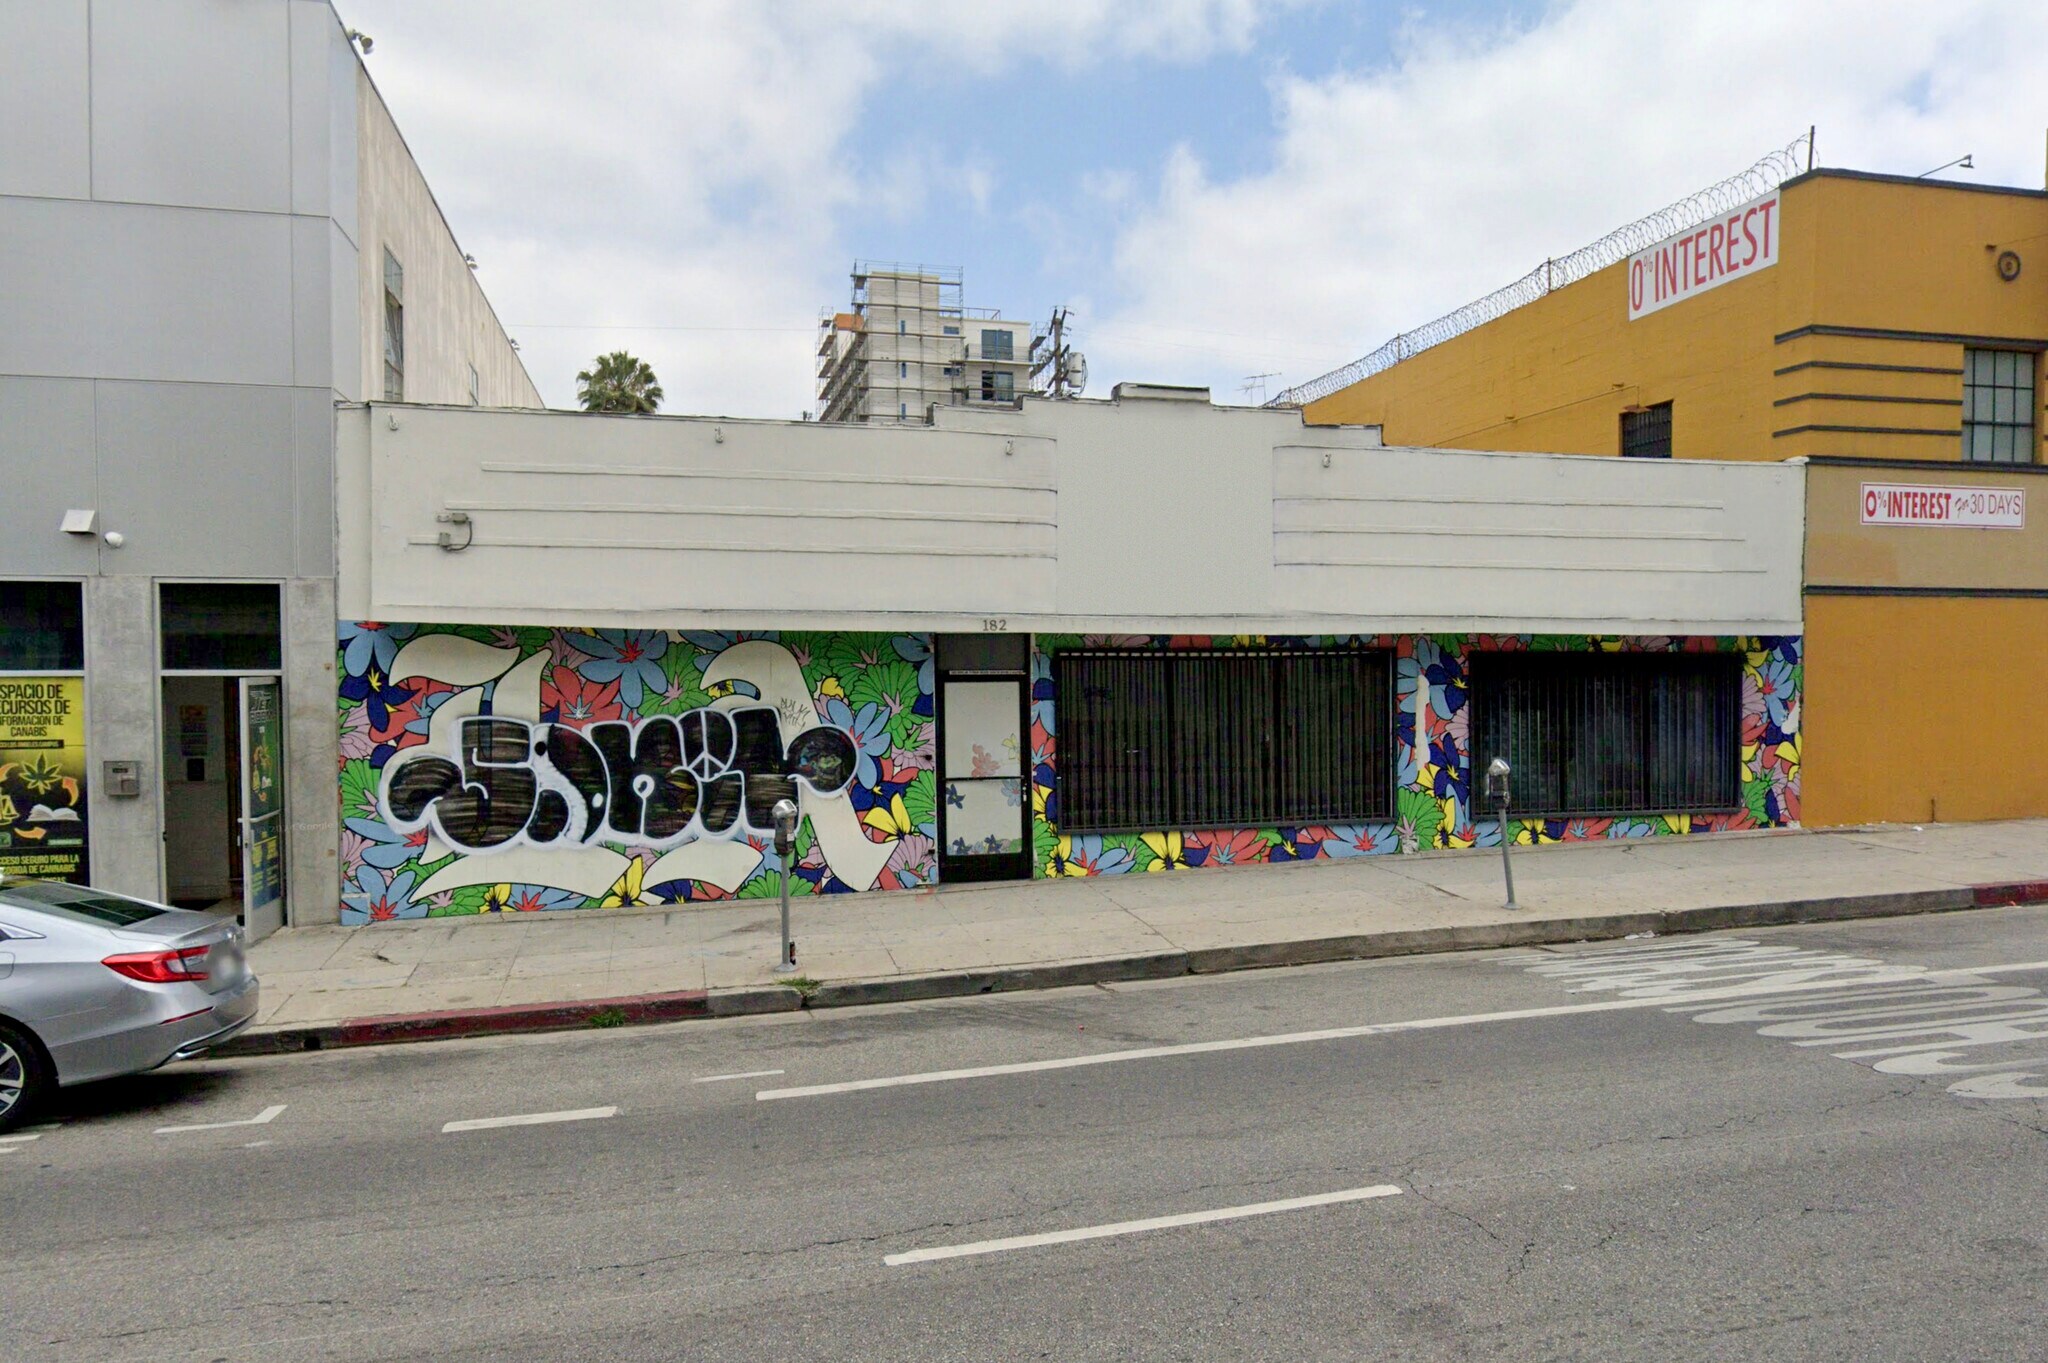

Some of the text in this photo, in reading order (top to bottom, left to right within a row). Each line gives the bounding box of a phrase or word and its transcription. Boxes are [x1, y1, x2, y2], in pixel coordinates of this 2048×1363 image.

[1631, 198, 1777, 312] 0% INTEREST
[1865, 490, 1887, 517] 0%
[1887, 491, 1952, 519] INTEREST
[1970, 494, 1985, 514] 30
[1988, 494, 2021, 516] DAYS
[983, 619, 1007, 631] 182
[47, 684, 64, 699] DE
[0, 700, 71, 715] CURSOS DE
[53, 715, 64, 726] DE
[10, 726, 48, 737] CANABIS
[21, 855, 49, 864] SEGURO
[50, 855, 69, 863] PARA
[70, 854, 80, 863] LA
[29, 865, 39, 874] DE
[1662, 972, 2048, 1100] HOOL
